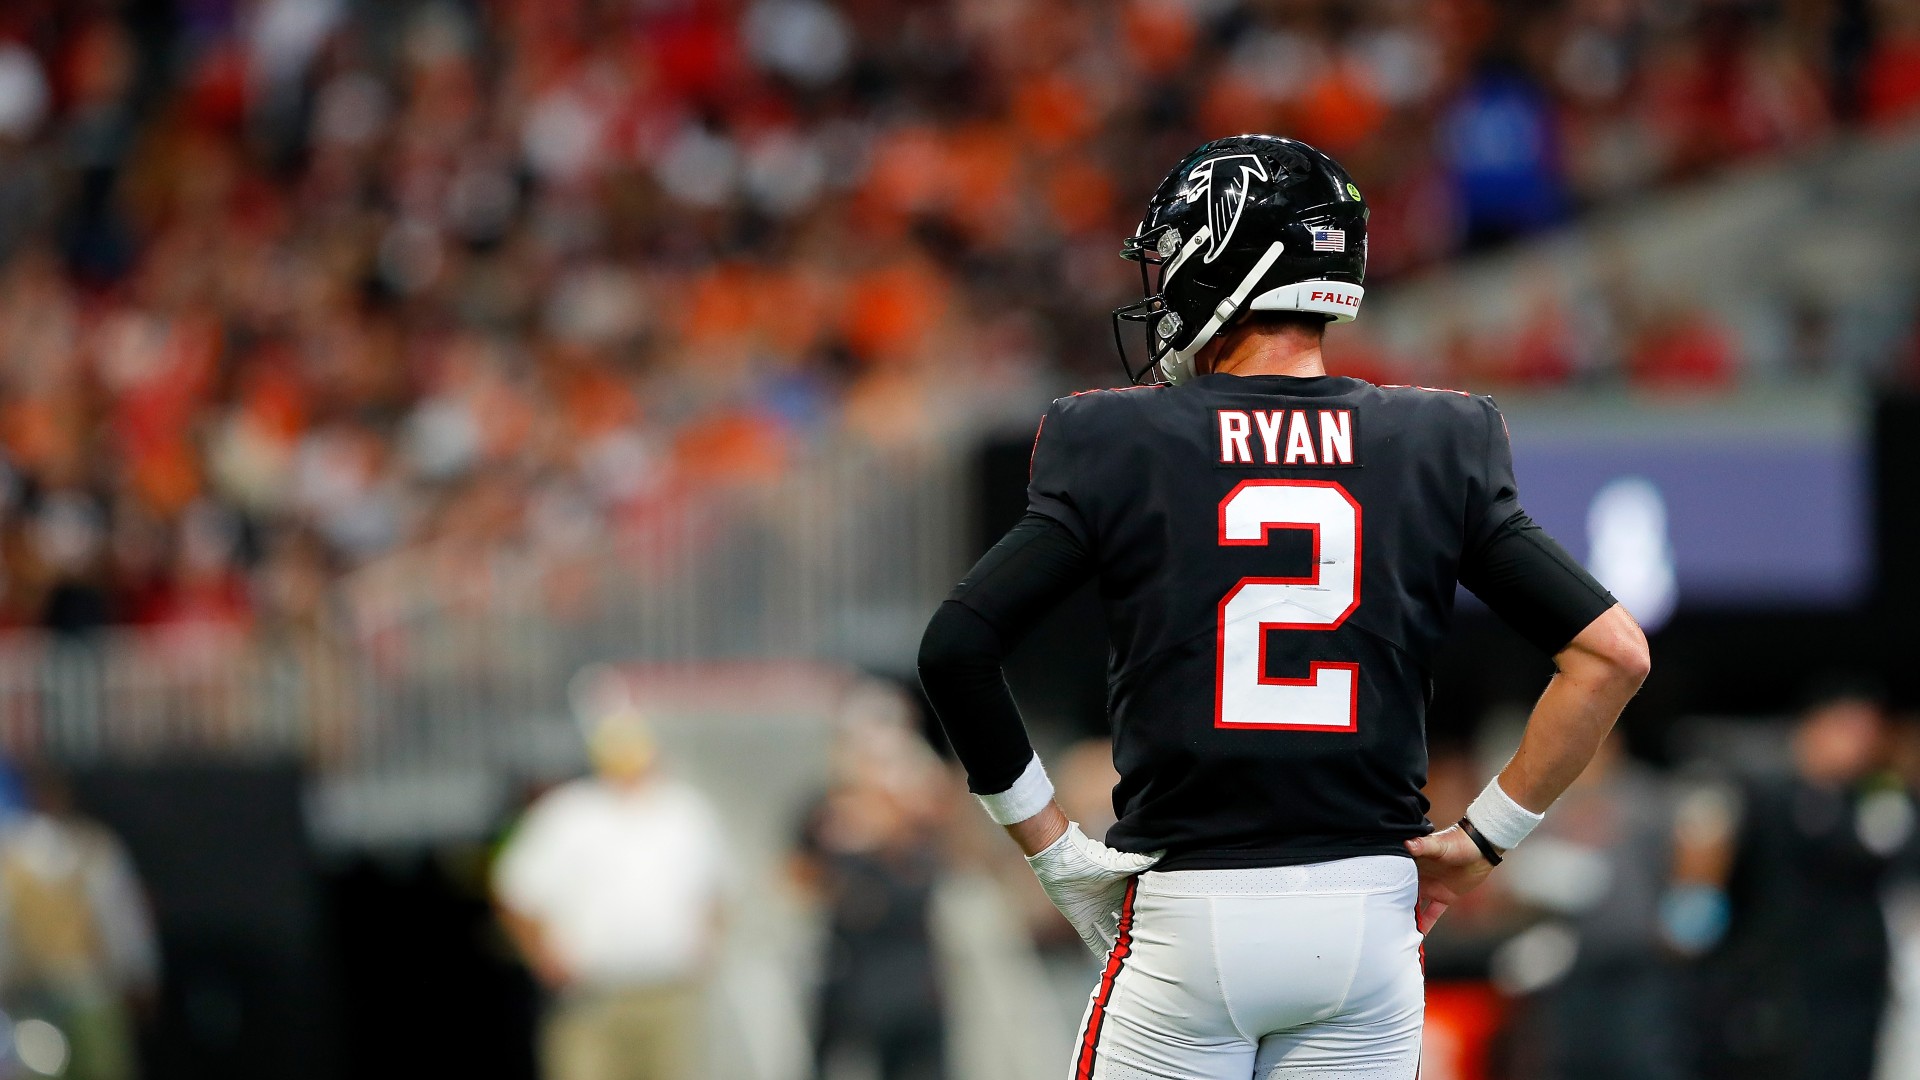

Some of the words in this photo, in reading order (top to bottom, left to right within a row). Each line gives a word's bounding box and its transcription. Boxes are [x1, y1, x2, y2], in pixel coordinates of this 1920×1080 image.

[1311, 291, 1361, 308] FALCO
[1218, 410, 1353, 465] RYAN
[1215, 479, 1362, 732] 2
